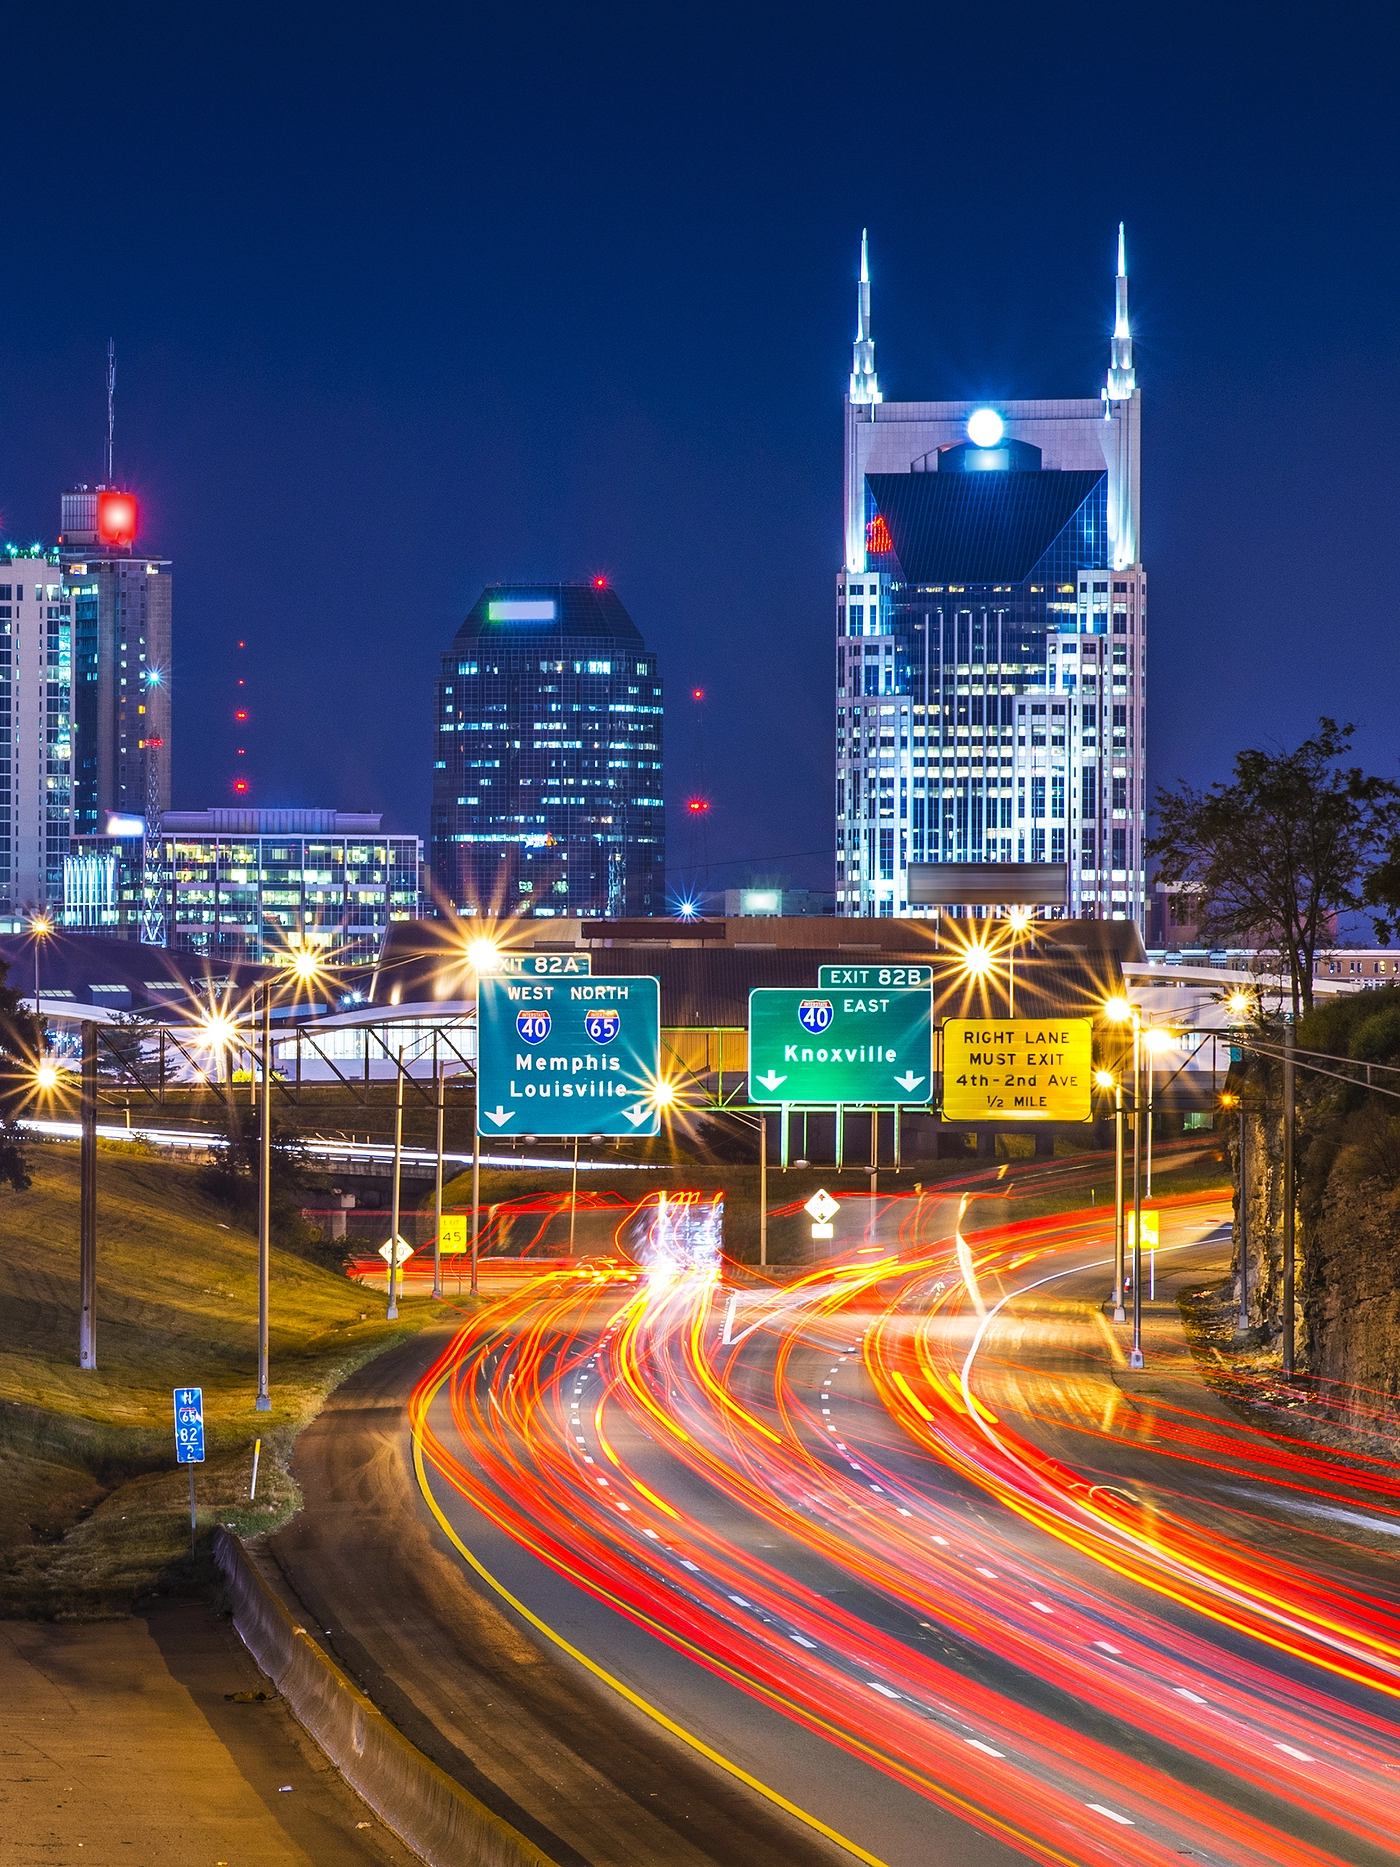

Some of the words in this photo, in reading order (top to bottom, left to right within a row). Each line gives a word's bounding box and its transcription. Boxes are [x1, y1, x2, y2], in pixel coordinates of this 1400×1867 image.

[489, 958, 525, 973] EXIT
[534, 957, 580, 973] 82A
[830, 970, 870, 984] EXIT
[878, 969, 921, 985] 82B
[507, 986, 554, 1000] WEST
[570, 986, 629, 1000] NORTH
[843, 999, 890, 1013] EAST
[803, 1008, 828, 1027] 40
[521, 1019, 547, 1038] 40
[590, 1019, 615, 1038] 65
[964, 1031, 1015, 1044] RIGHT
[1025, 1032, 1070, 1044] LANE
[784, 1044, 897, 1063] Knoxville
[970, 1053, 1016, 1065] MUST
[1027, 1053, 1064, 1065] EXIT
[516, 1053, 621, 1074] Memphis
[510, 1080, 627, 1097] Louisville
[1014, 1096, 1047, 1107] MILE
[443, 1232, 461, 1242] 45
[184, 1391, 192, 1404] N
[182, 1411, 196, 1422] 65
[180, 1428, 197, 1442] 82
